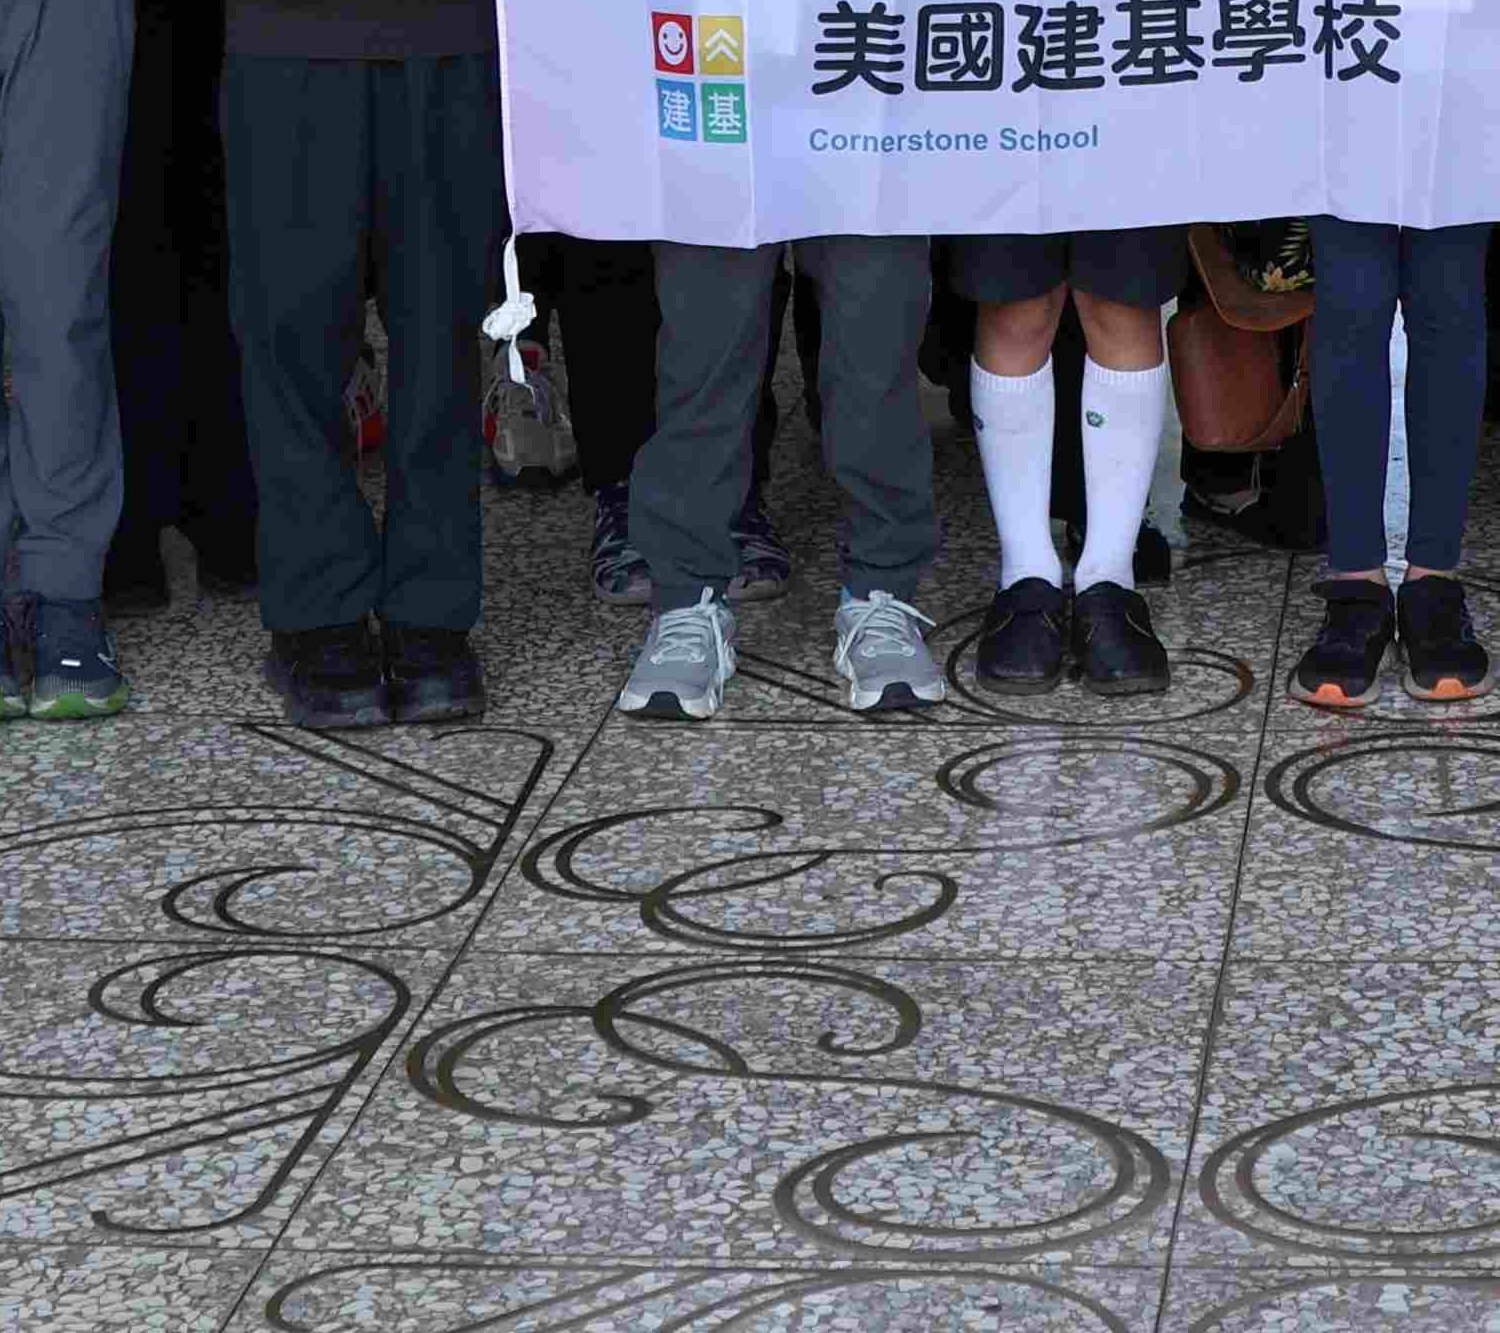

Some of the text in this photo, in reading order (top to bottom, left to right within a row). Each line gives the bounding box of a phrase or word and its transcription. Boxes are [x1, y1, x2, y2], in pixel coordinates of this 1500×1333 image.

[661, 89, 742, 135] 建基
[808, 123, 1100, 154] Cornerstone School
